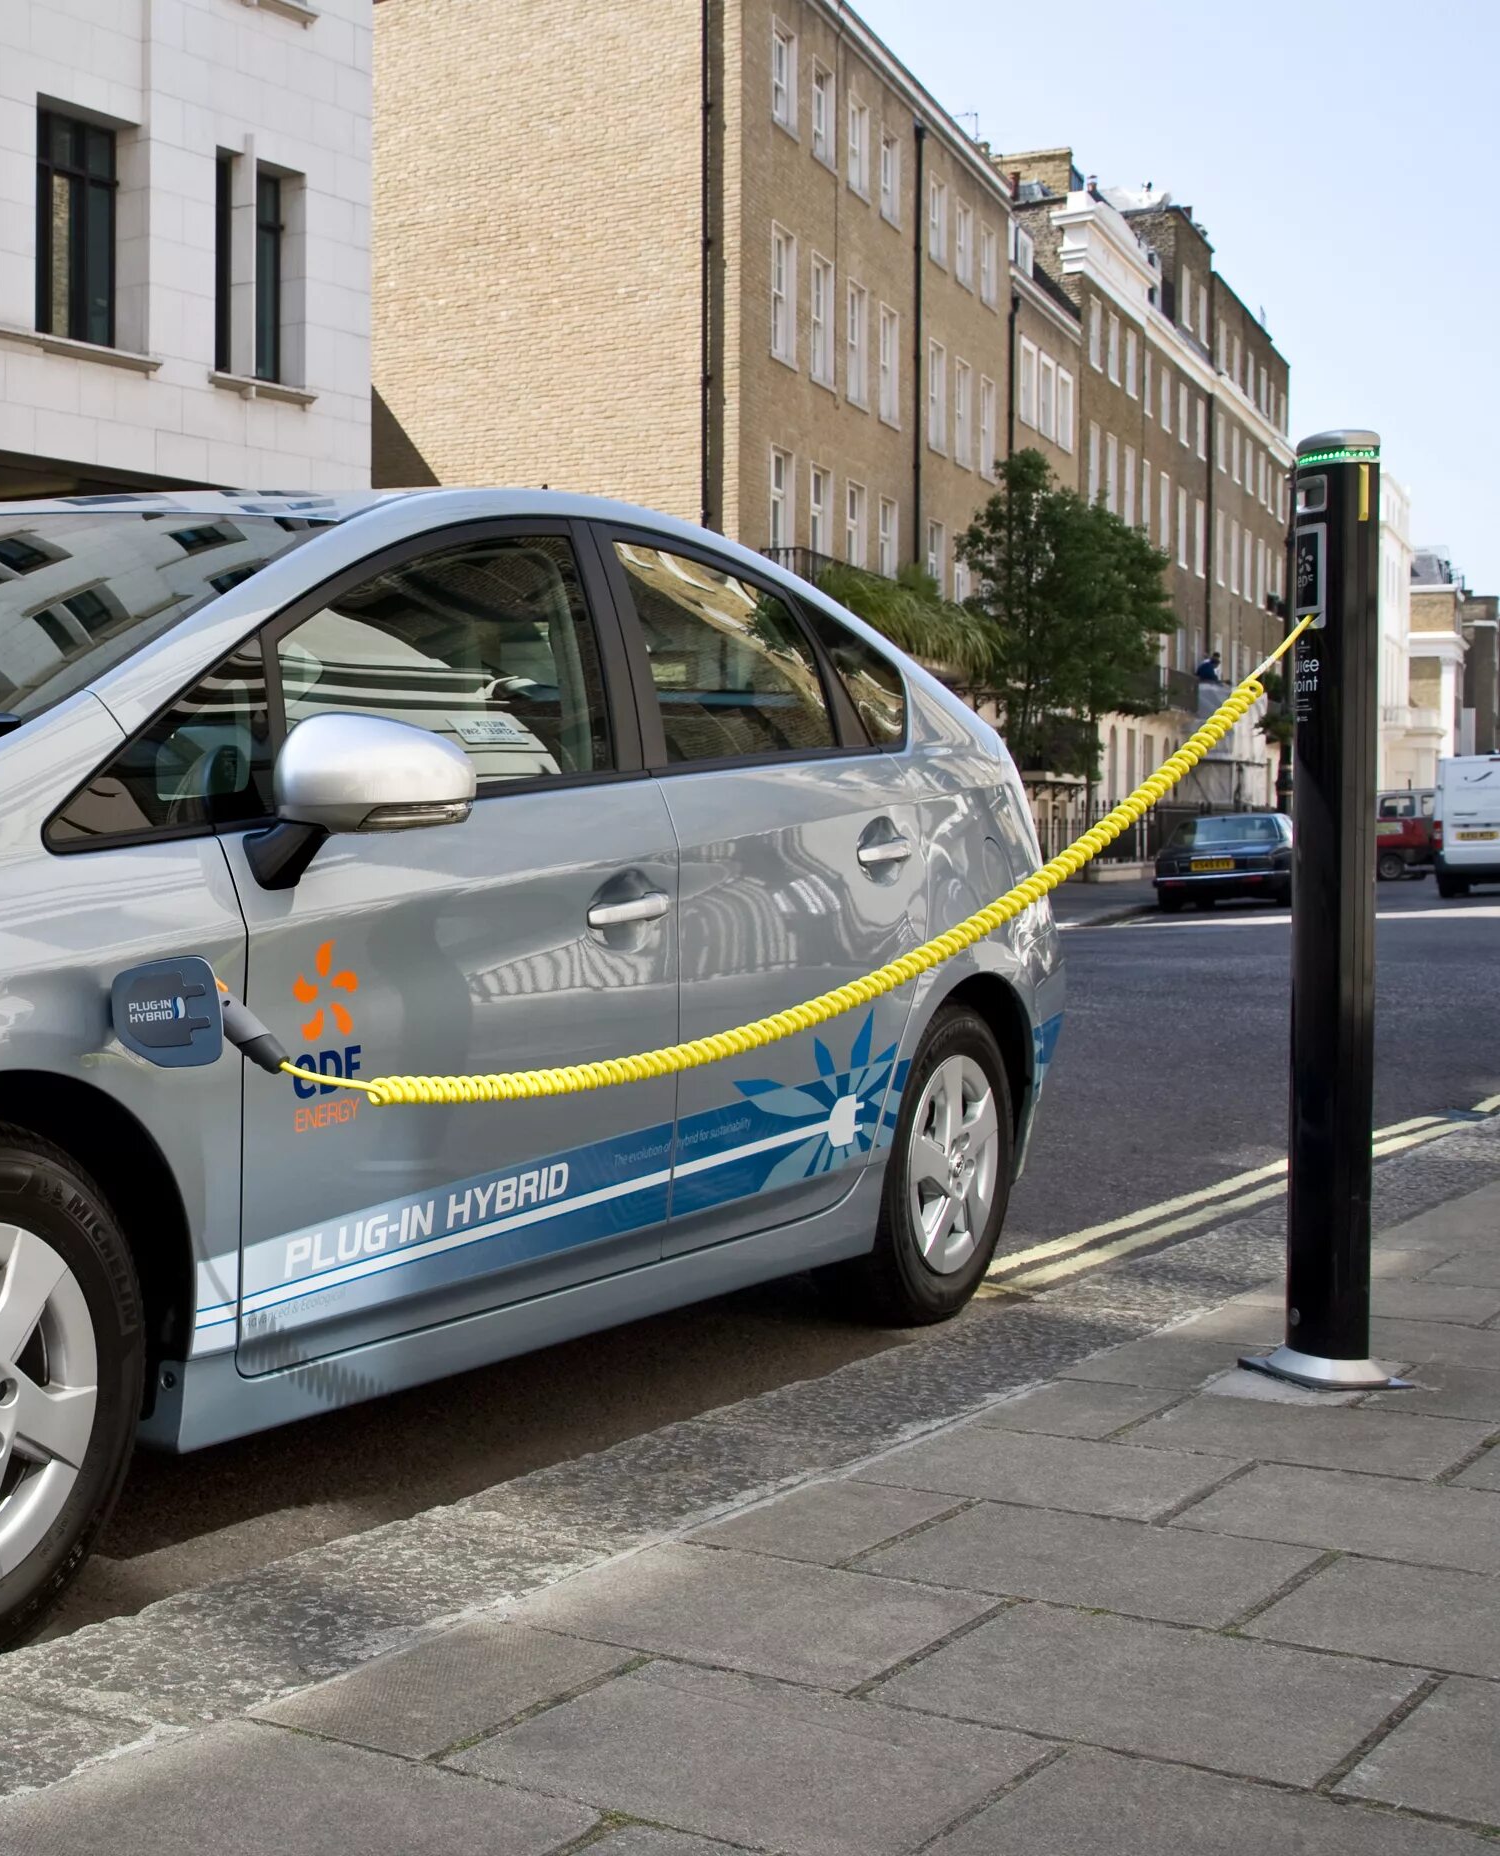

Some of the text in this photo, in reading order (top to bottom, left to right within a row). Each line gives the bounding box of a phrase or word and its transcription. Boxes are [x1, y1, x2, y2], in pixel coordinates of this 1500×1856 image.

[128, 999, 172, 1013] PLUG-IN
[129, 1010, 173, 1024] HYBRID
[294, 1097, 361, 1134] ENERGY
[613, 1153, 628, 1167] The
[628, 1144, 663, 1163] evolution
[675, 1129, 699, 1149] hybrid
[699, 1129, 709, 1142] for
[709, 1117, 752, 1140] sustainability
[284, 1162, 569, 1279] PLUG-IN HYBRID
[67, 1193, 139, 1327] MICHELIN
[301, 1286, 348, 1310] Ecological
